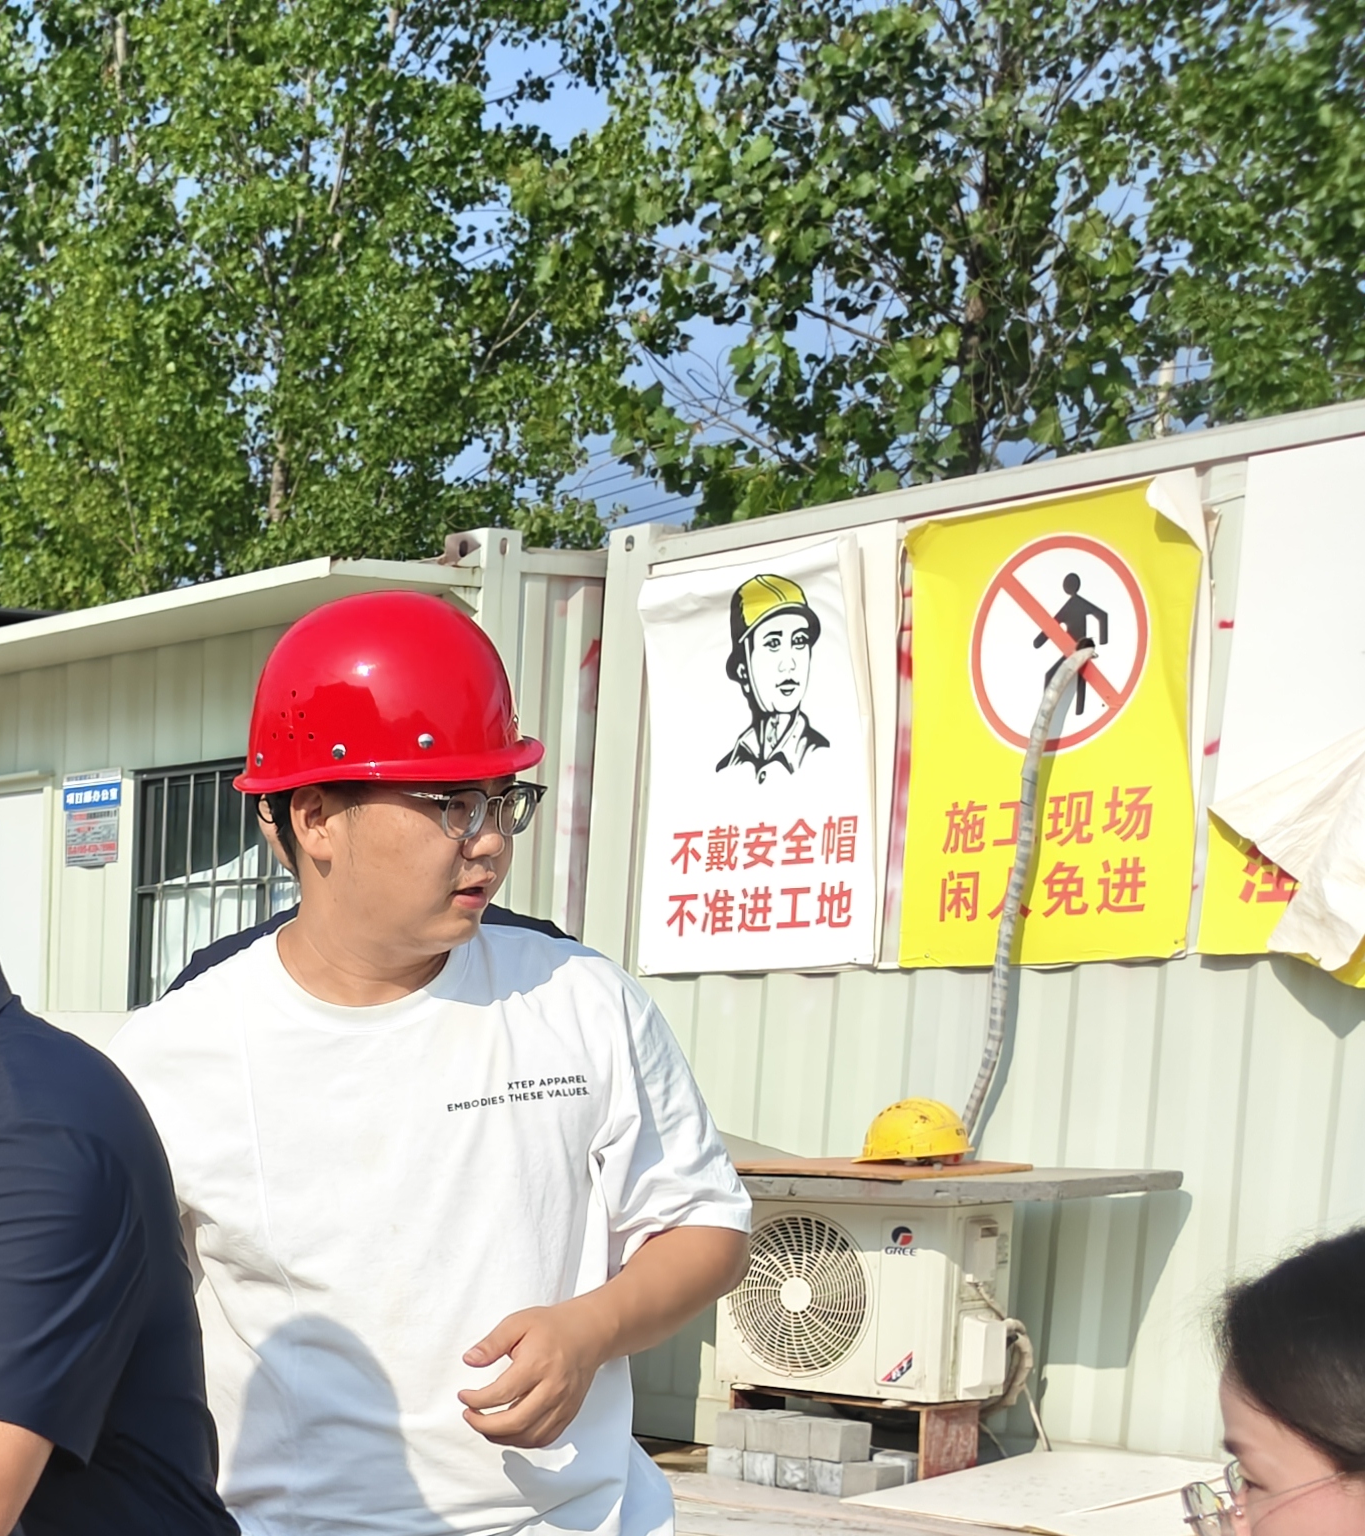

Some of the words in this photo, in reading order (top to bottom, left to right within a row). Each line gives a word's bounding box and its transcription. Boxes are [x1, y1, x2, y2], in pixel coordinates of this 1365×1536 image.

[670, 815, 858, 875] 不戴安全帽
[942, 785, 1153, 855] 施工现场
[666, 881, 853, 937] 不准进工地
[939, 856, 1147, 922] 闲人免进
[447, 1095, 505, 1112] EMBODIES
[508, 1090, 544, 1102] THESE
[507, 1079, 535, 1090] XTEP
[539, 1074, 587, 1087] APPAREL
[884, 1246, 917, 1257] GREE
